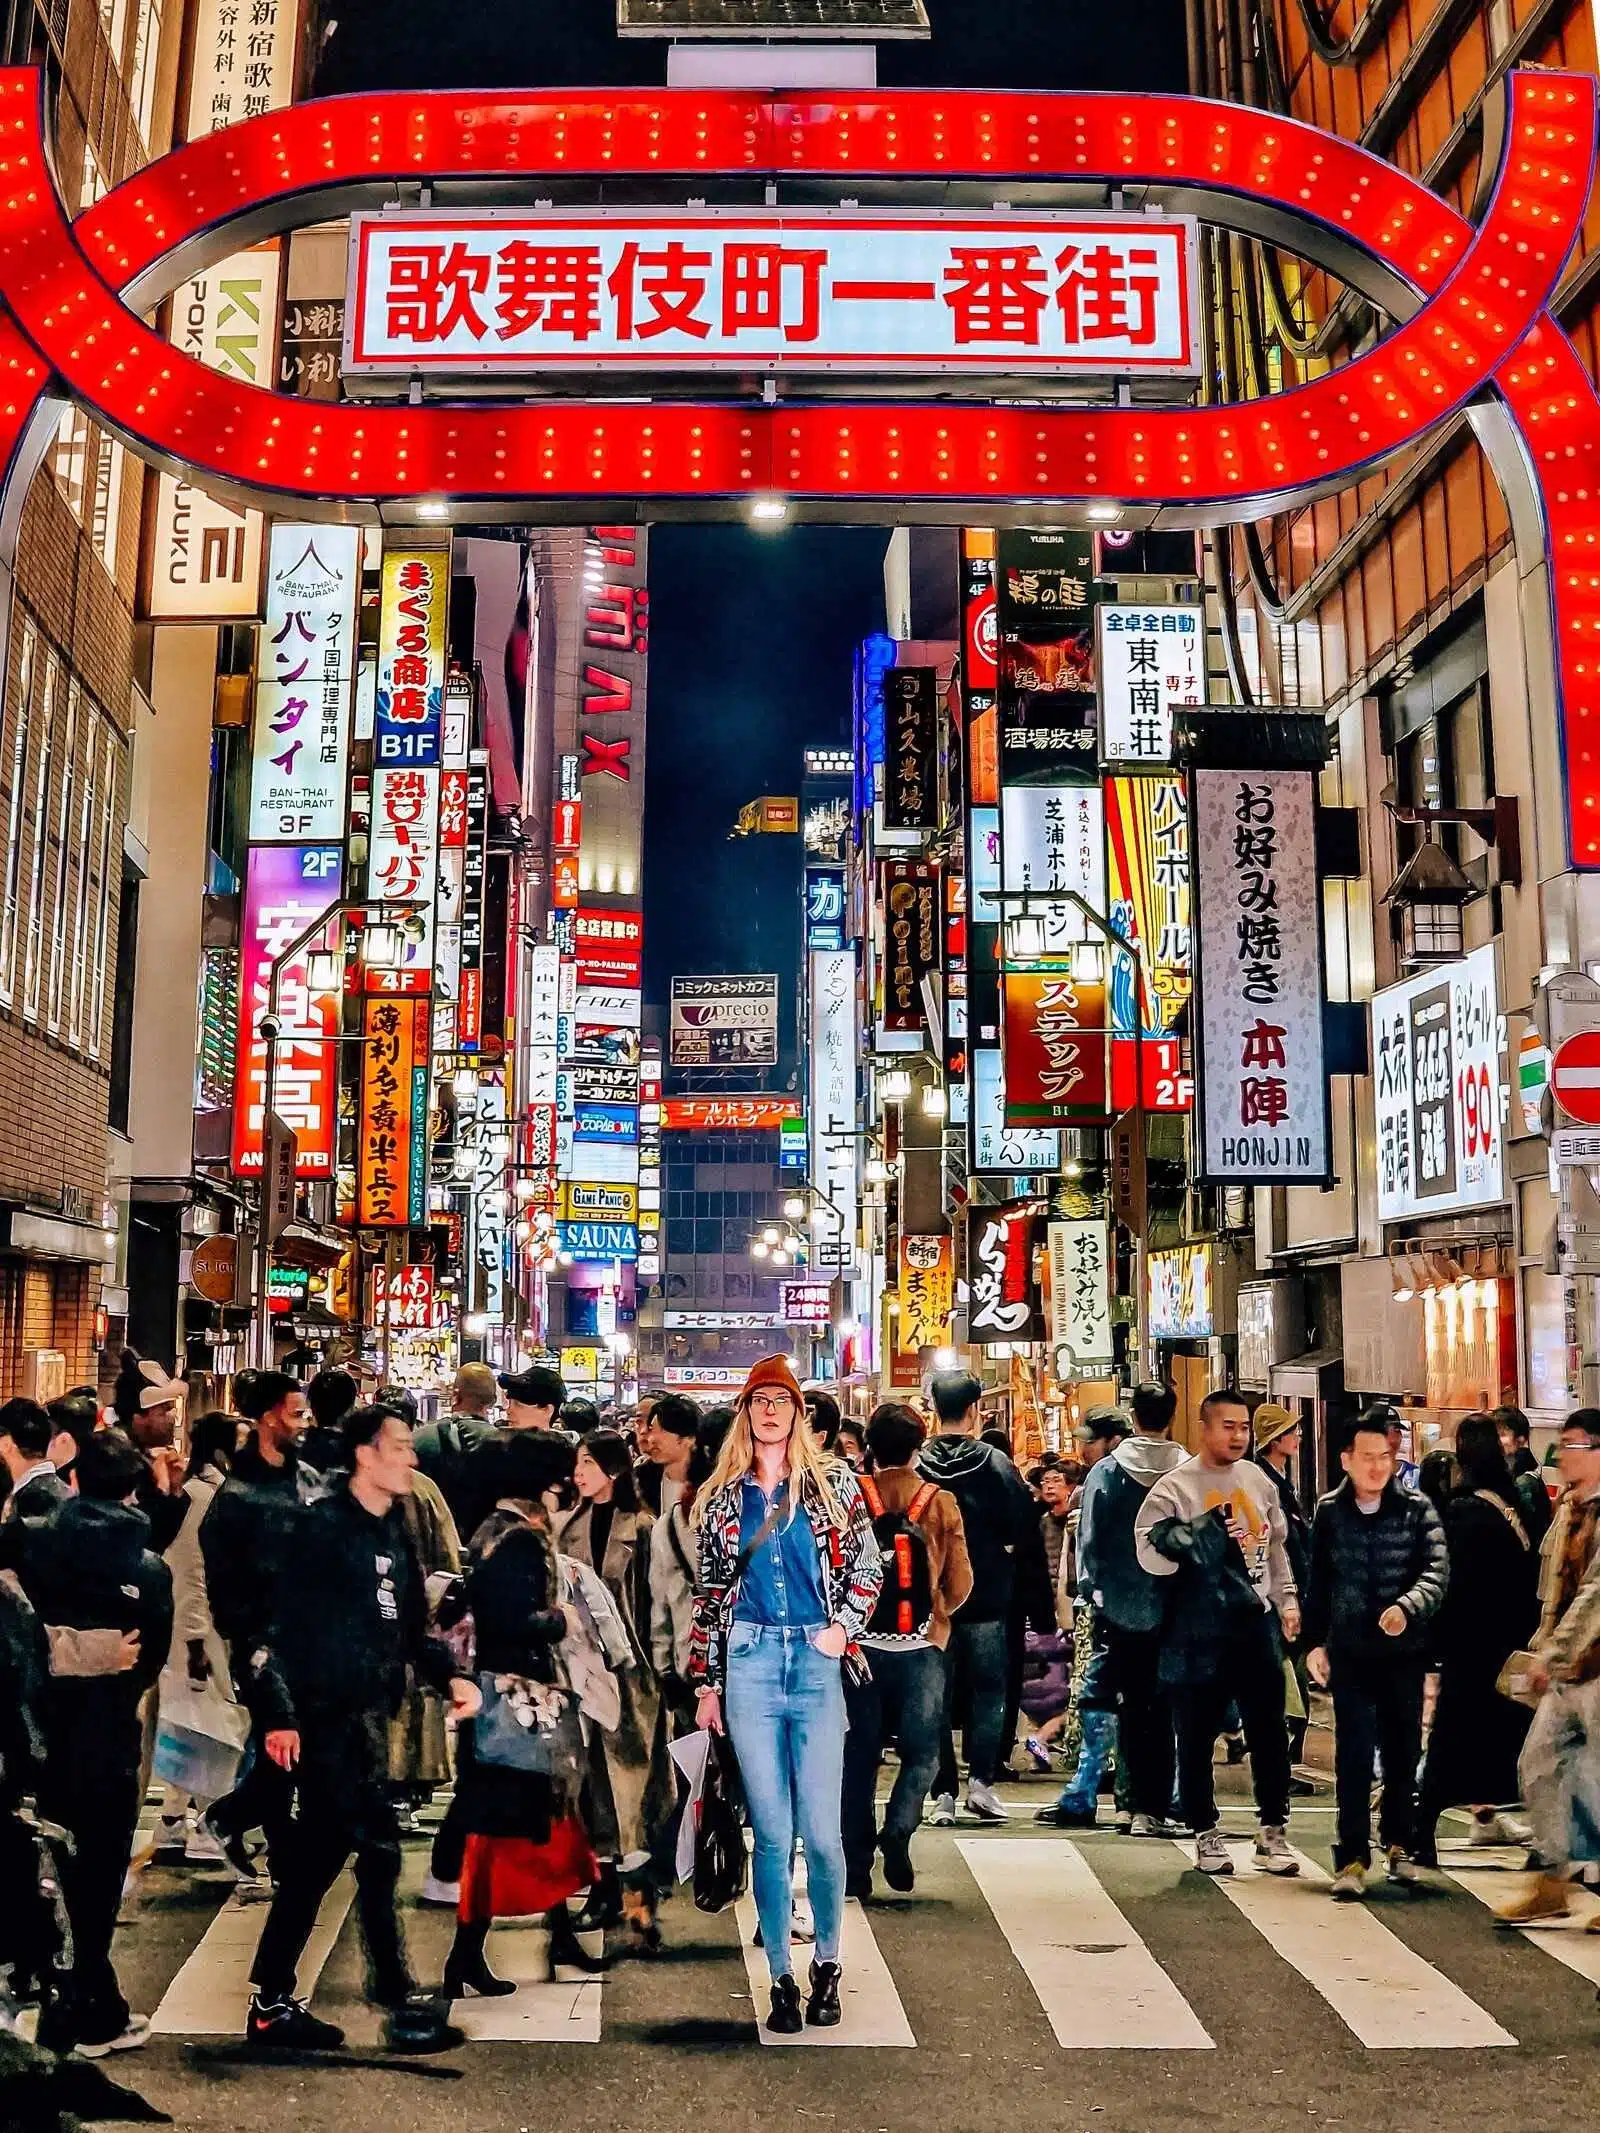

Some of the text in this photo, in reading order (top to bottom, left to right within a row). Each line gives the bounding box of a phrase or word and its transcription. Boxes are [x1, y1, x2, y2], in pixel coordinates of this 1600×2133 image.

[386, 241, 1159, 345] 歌舞伎町一番街
[284, 306, 344, 338] 小料
[276, 578, 343, 599] BAN-THAI RESTAURANT
[1106, 613, 1196, 633] 全卓全自動
[391, 561, 434, 723] まぐろ商店
[270, 610, 317, 775] バンタイ
[319, 611, 344, 763] タイ国料理専門店
[1126, 638, 1163, 757] 東南荘
[970, 696, 992, 710] 3F
[381, 734, 434, 757] B1F
[1004, 728, 1097, 750] 酒場牧場
[1110, 743, 1125, 756] 3F
[260, 788, 335, 809] BAN-THAI RESTAURANT
[278, 816, 314, 834] 3F
[302, 851, 339, 878] 2F
[1045, 798, 1067, 937] 芝浦ホルモン
[1153, 785, 1190, 961] ハイボール
[1232, 783, 1281, 1005] お好み焼き
[380, 973, 415, 990] 4F
[575, 994, 636, 1010] FACE
[1034, 978, 1084, 1101] ステップ
[1240, 1018, 1290, 1127] 本陣
[557, 1073, 567, 1112] GiGO
[1457, 1060, 1492, 1160] 190
[1222, 1137, 1310, 1167] HONJIN
[573, 1187, 623, 1206] GAME PANIC
[567, 1224, 637, 1249] SAUNA
